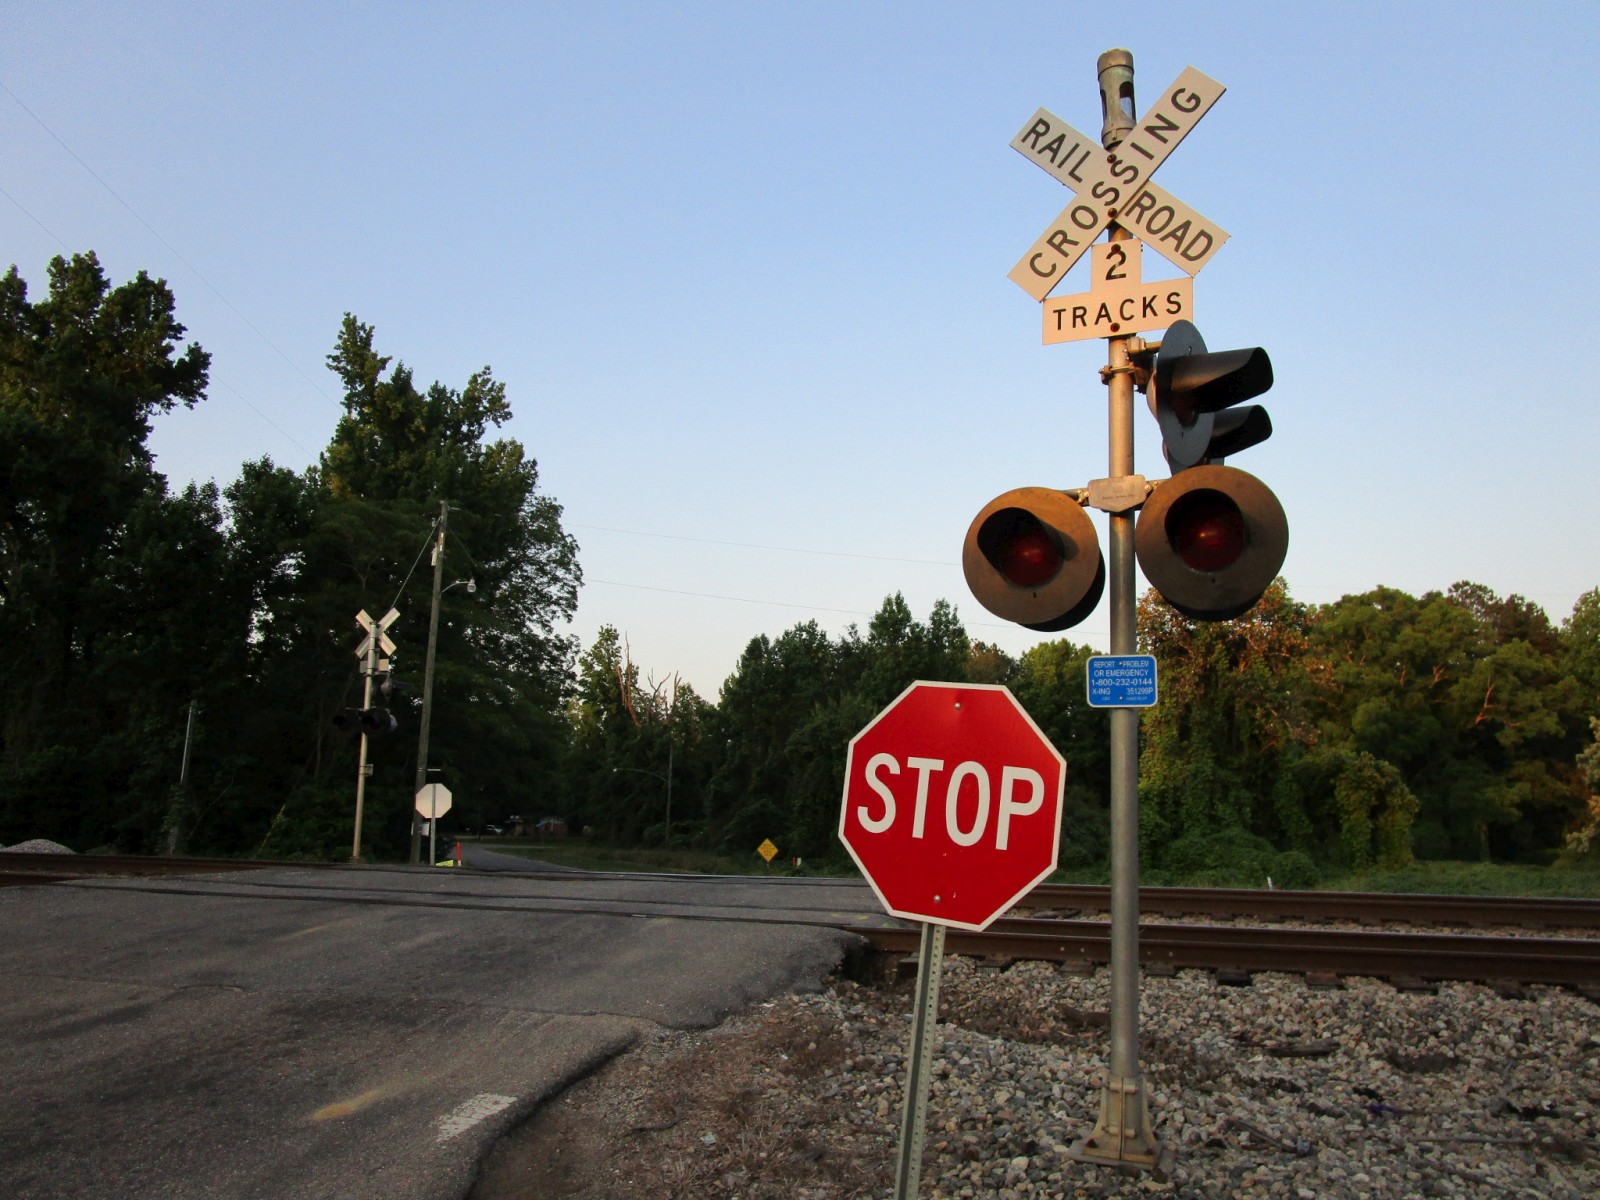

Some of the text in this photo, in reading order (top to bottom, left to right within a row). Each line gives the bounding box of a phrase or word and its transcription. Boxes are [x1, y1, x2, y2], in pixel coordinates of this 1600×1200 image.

[1021, 118, 1214, 262] RAIL ROAD
[1029, 87, 1201, 279] CROSSING
[1105, 247, 1127, 281] 2
[1052, 291, 1182, 331] TRACKS
[1091, 678, 1152, 686] 1-800-232-0144
[1106, 669, 1149, 677] EMERGENCY
[858, 753, 1045, 850] STOP
